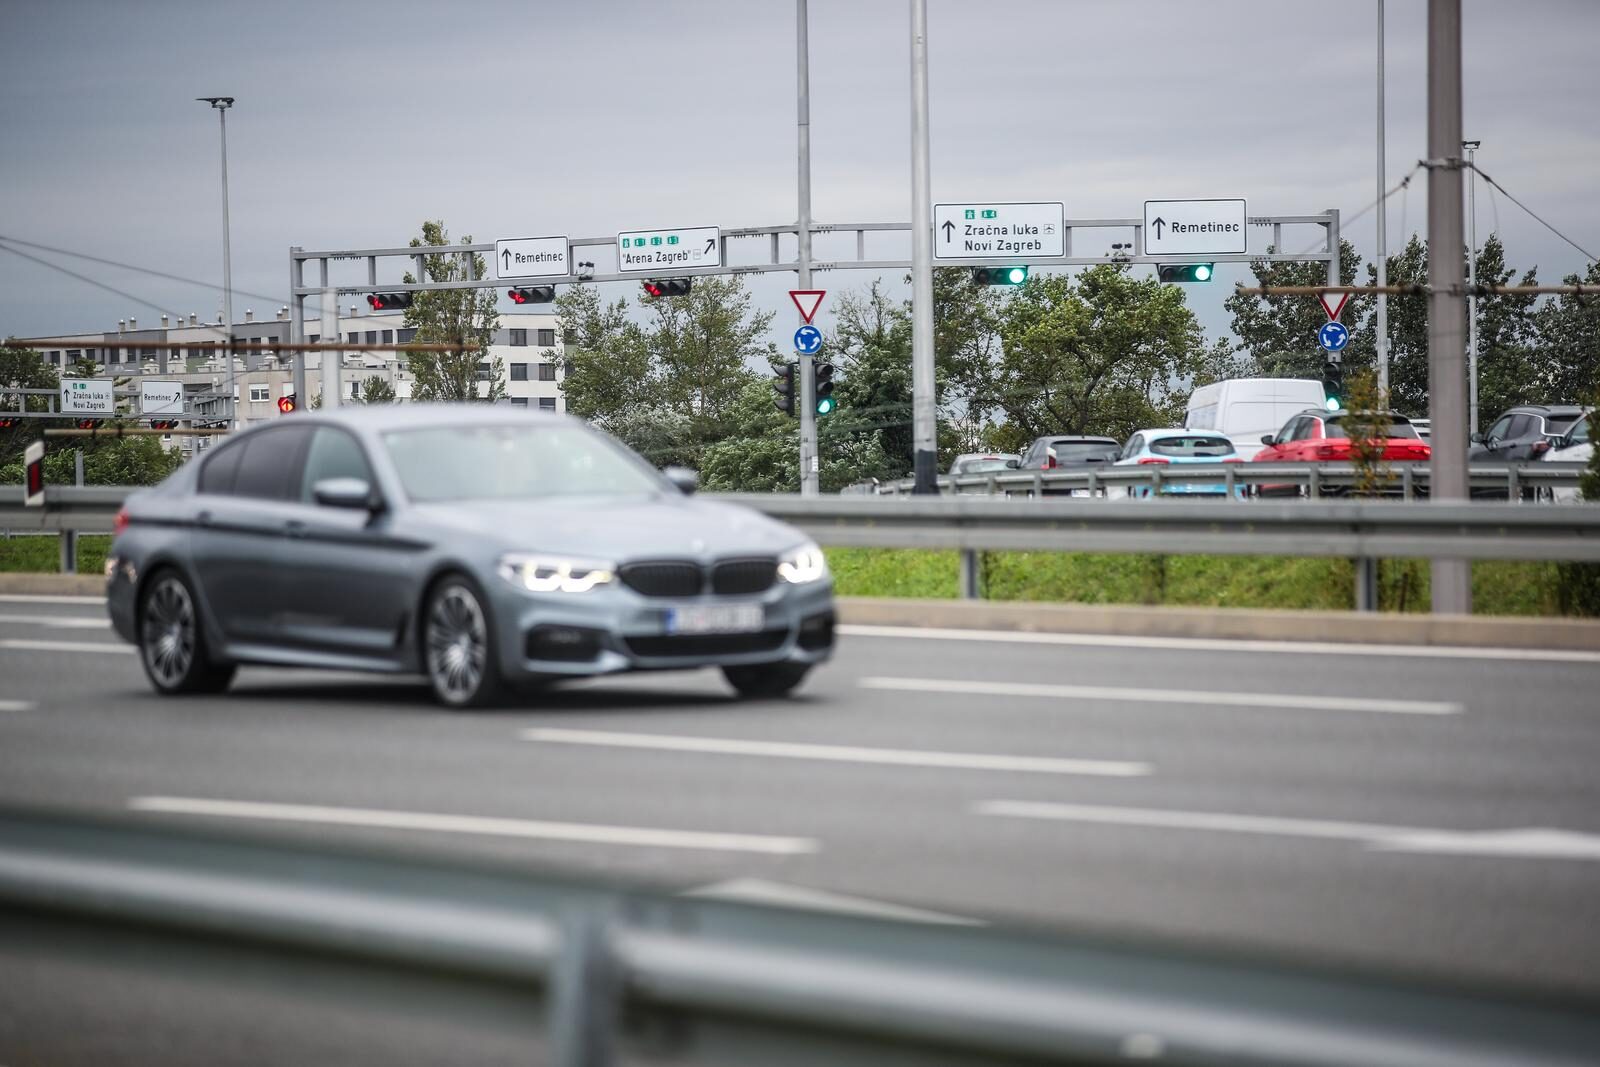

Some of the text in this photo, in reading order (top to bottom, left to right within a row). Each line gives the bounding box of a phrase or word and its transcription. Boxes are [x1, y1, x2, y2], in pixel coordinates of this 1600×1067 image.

[965, 223, 1039, 236] Zračna luka
[1172, 221, 1239, 233] Remetinec
[965, 239, 1042, 253] Novi Zagreb
[515, 251, 563, 263] Remetinec
[622, 249, 691, 264] "Arena Zagreb"
[93, 391, 104, 400] luka
[144, 393, 171, 401] Remetinec
[73, 401, 105, 410] Novi Zagreb
